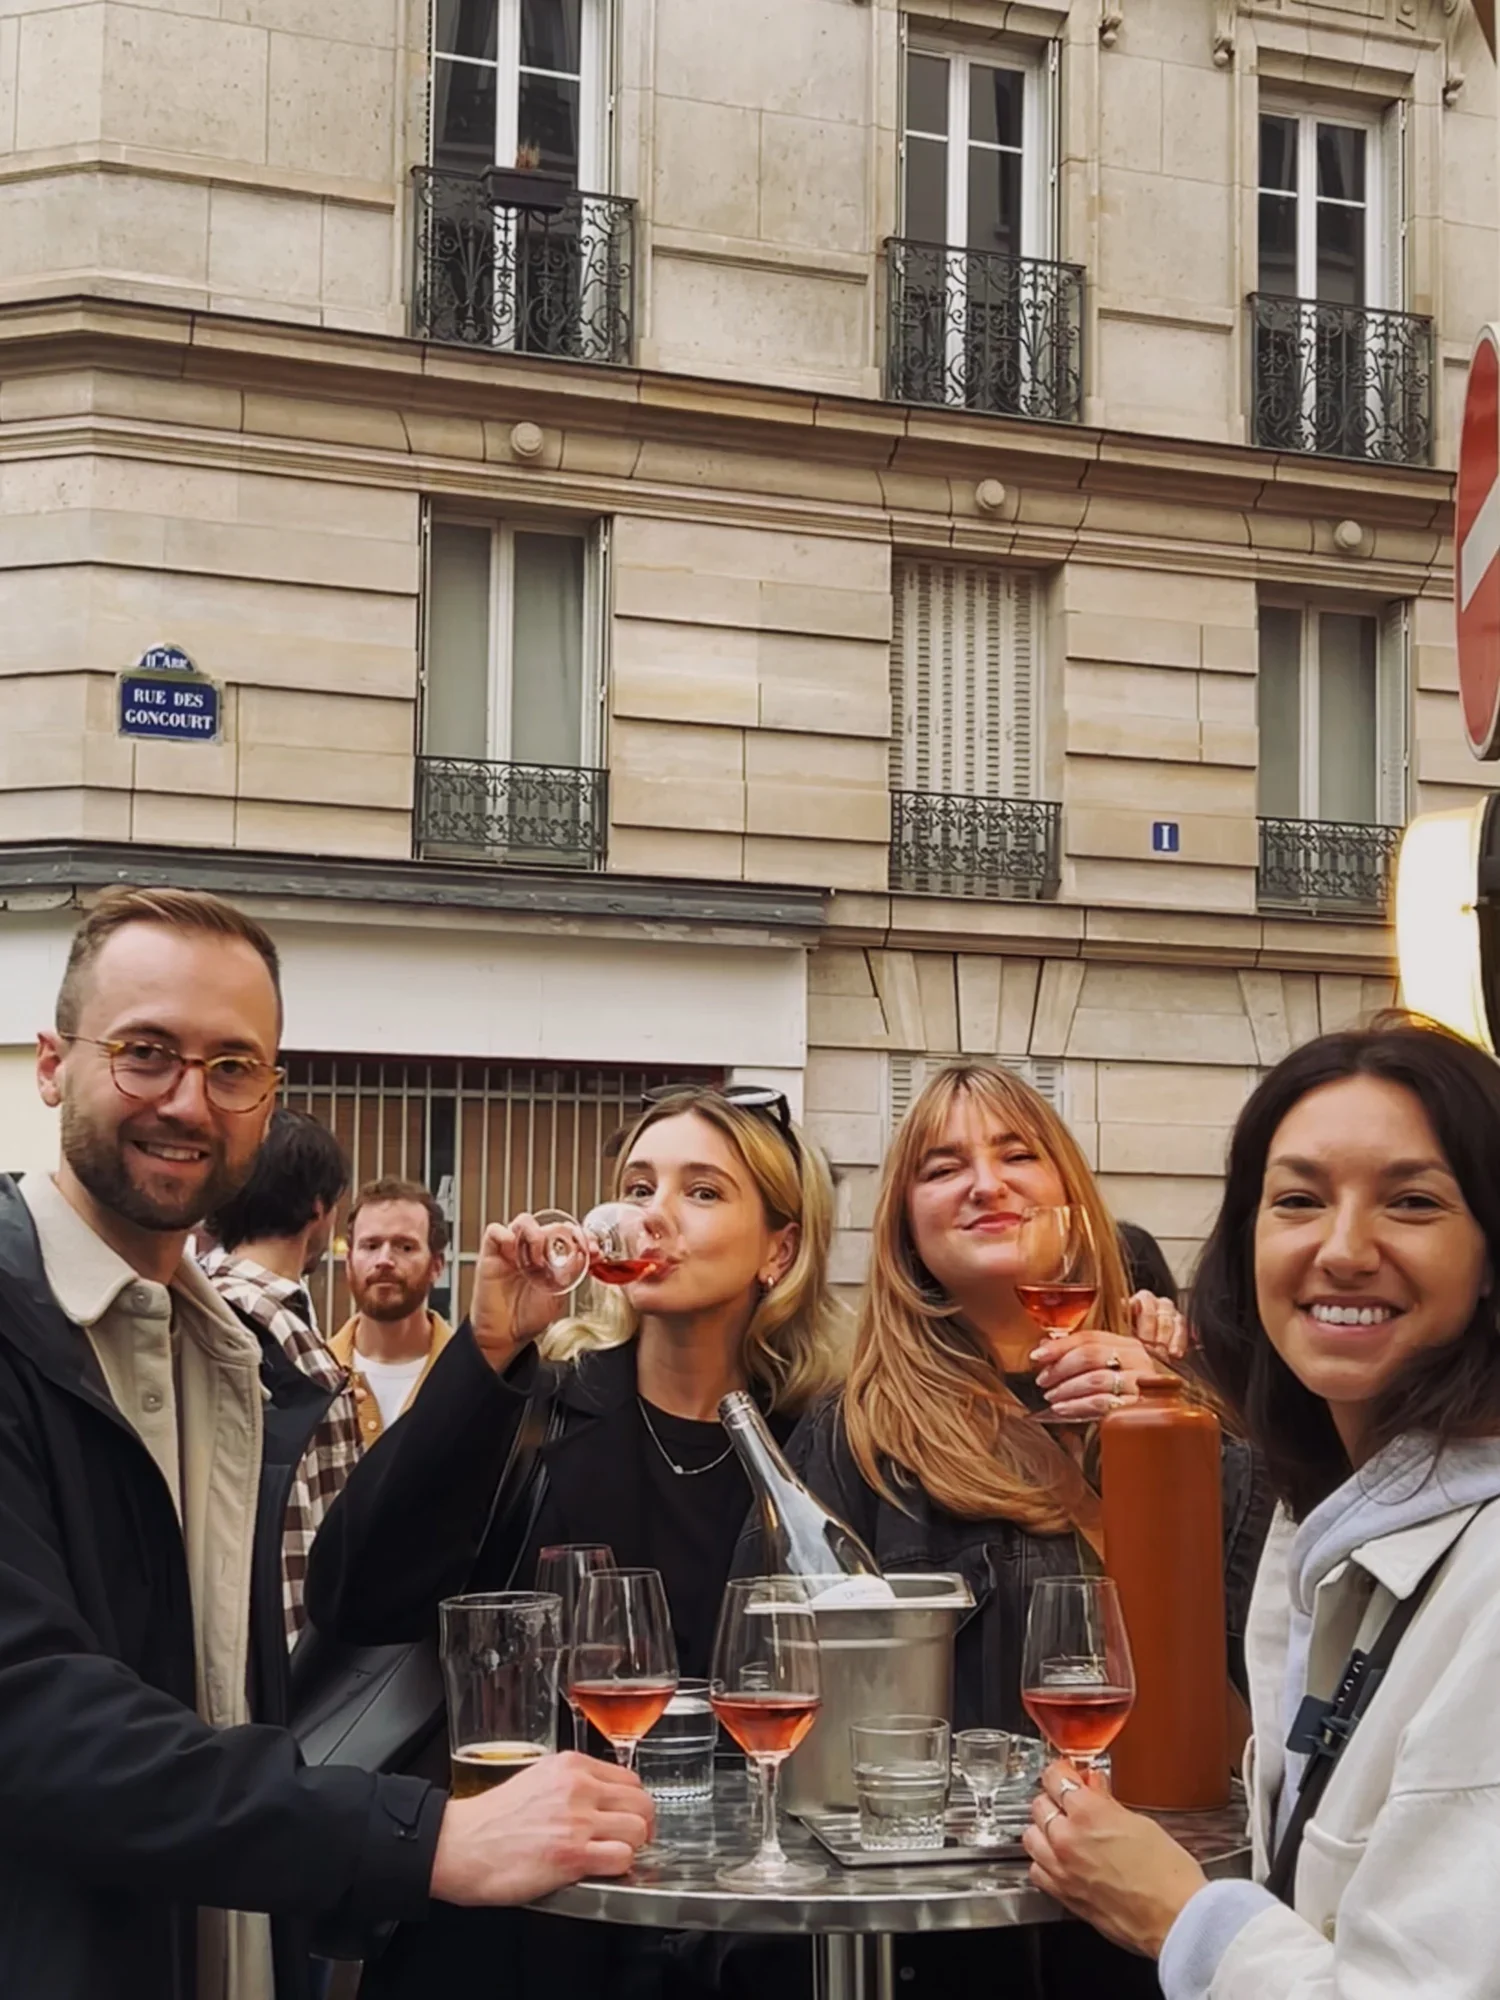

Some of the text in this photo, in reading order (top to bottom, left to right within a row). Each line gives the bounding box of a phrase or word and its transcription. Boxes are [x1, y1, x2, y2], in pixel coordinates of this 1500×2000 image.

[133, 688, 204, 708] RUE DES
[125, 709, 214, 730] GONCOURT
